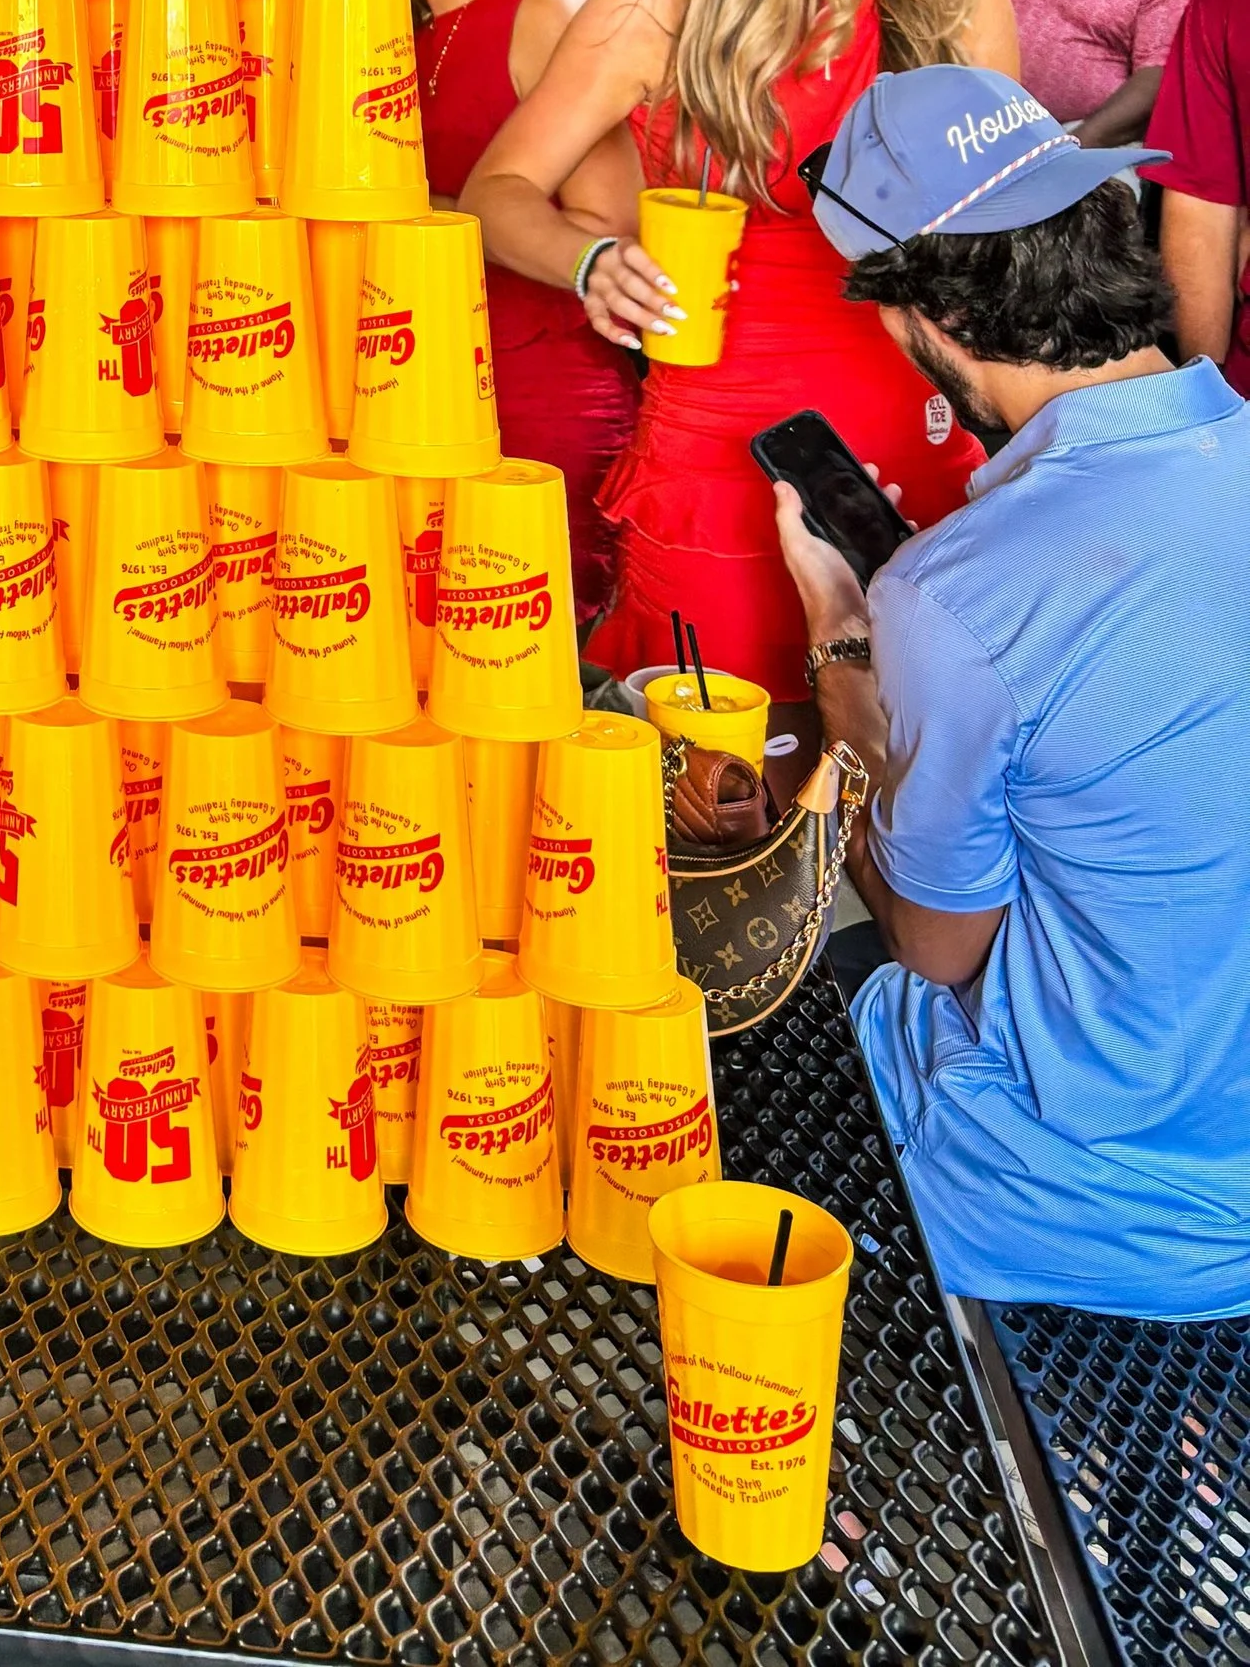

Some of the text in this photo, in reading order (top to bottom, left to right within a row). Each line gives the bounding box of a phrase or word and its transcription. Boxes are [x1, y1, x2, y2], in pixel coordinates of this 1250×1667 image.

[188, 319, 295, 362] Gallettes
[437, 591, 551, 632] Gallettes
[188, 802, 227, 814] Tradition
[209, 813, 258, 824] On the Strip
[231, 798, 269, 813] Gameday
[176, 824, 218, 841] Est. 1976
[192, 826, 276, 860] TUSCALOOSA
[175, 835, 288, 890] Gallettes
[336, 852, 444, 892] Gallettes
[177, 884, 286, 922] Home of the Yellow Hammer!
[122, 1054, 175, 1078] Gallettes
[102, 1085, 188, 1117] ANNIVERSARY
[447, 1089, 495, 1107] Est. 1976
[467, 1088, 545, 1126] TUSCALOOSA
[592, 1098, 636, 1122] Est. 1976
[88, 1077, 191, 1184] 50 TH
[593, 1112, 712, 1170] Gallettes
[610, 1112, 696, 1138] TUSCALOOSA
[596, 1166, 634, 1200] Hammer!
[699, 1354, 715, 1372] the
[716, 1360, 752, 1383] Yellow
[754, 1374, 802, 1399] Hammer!
[667, 1375, 807, 1434] Gallettes
[682, 1429, 785, 1453] TUSCALOOSA
[703, 1461, 762, 1492] On the Strip
[750, 1454, 806, 1471] Est. 1976
[690, 1464, 735, 1504] Gameday
[738, 1483, 790, 1504] Tradition
